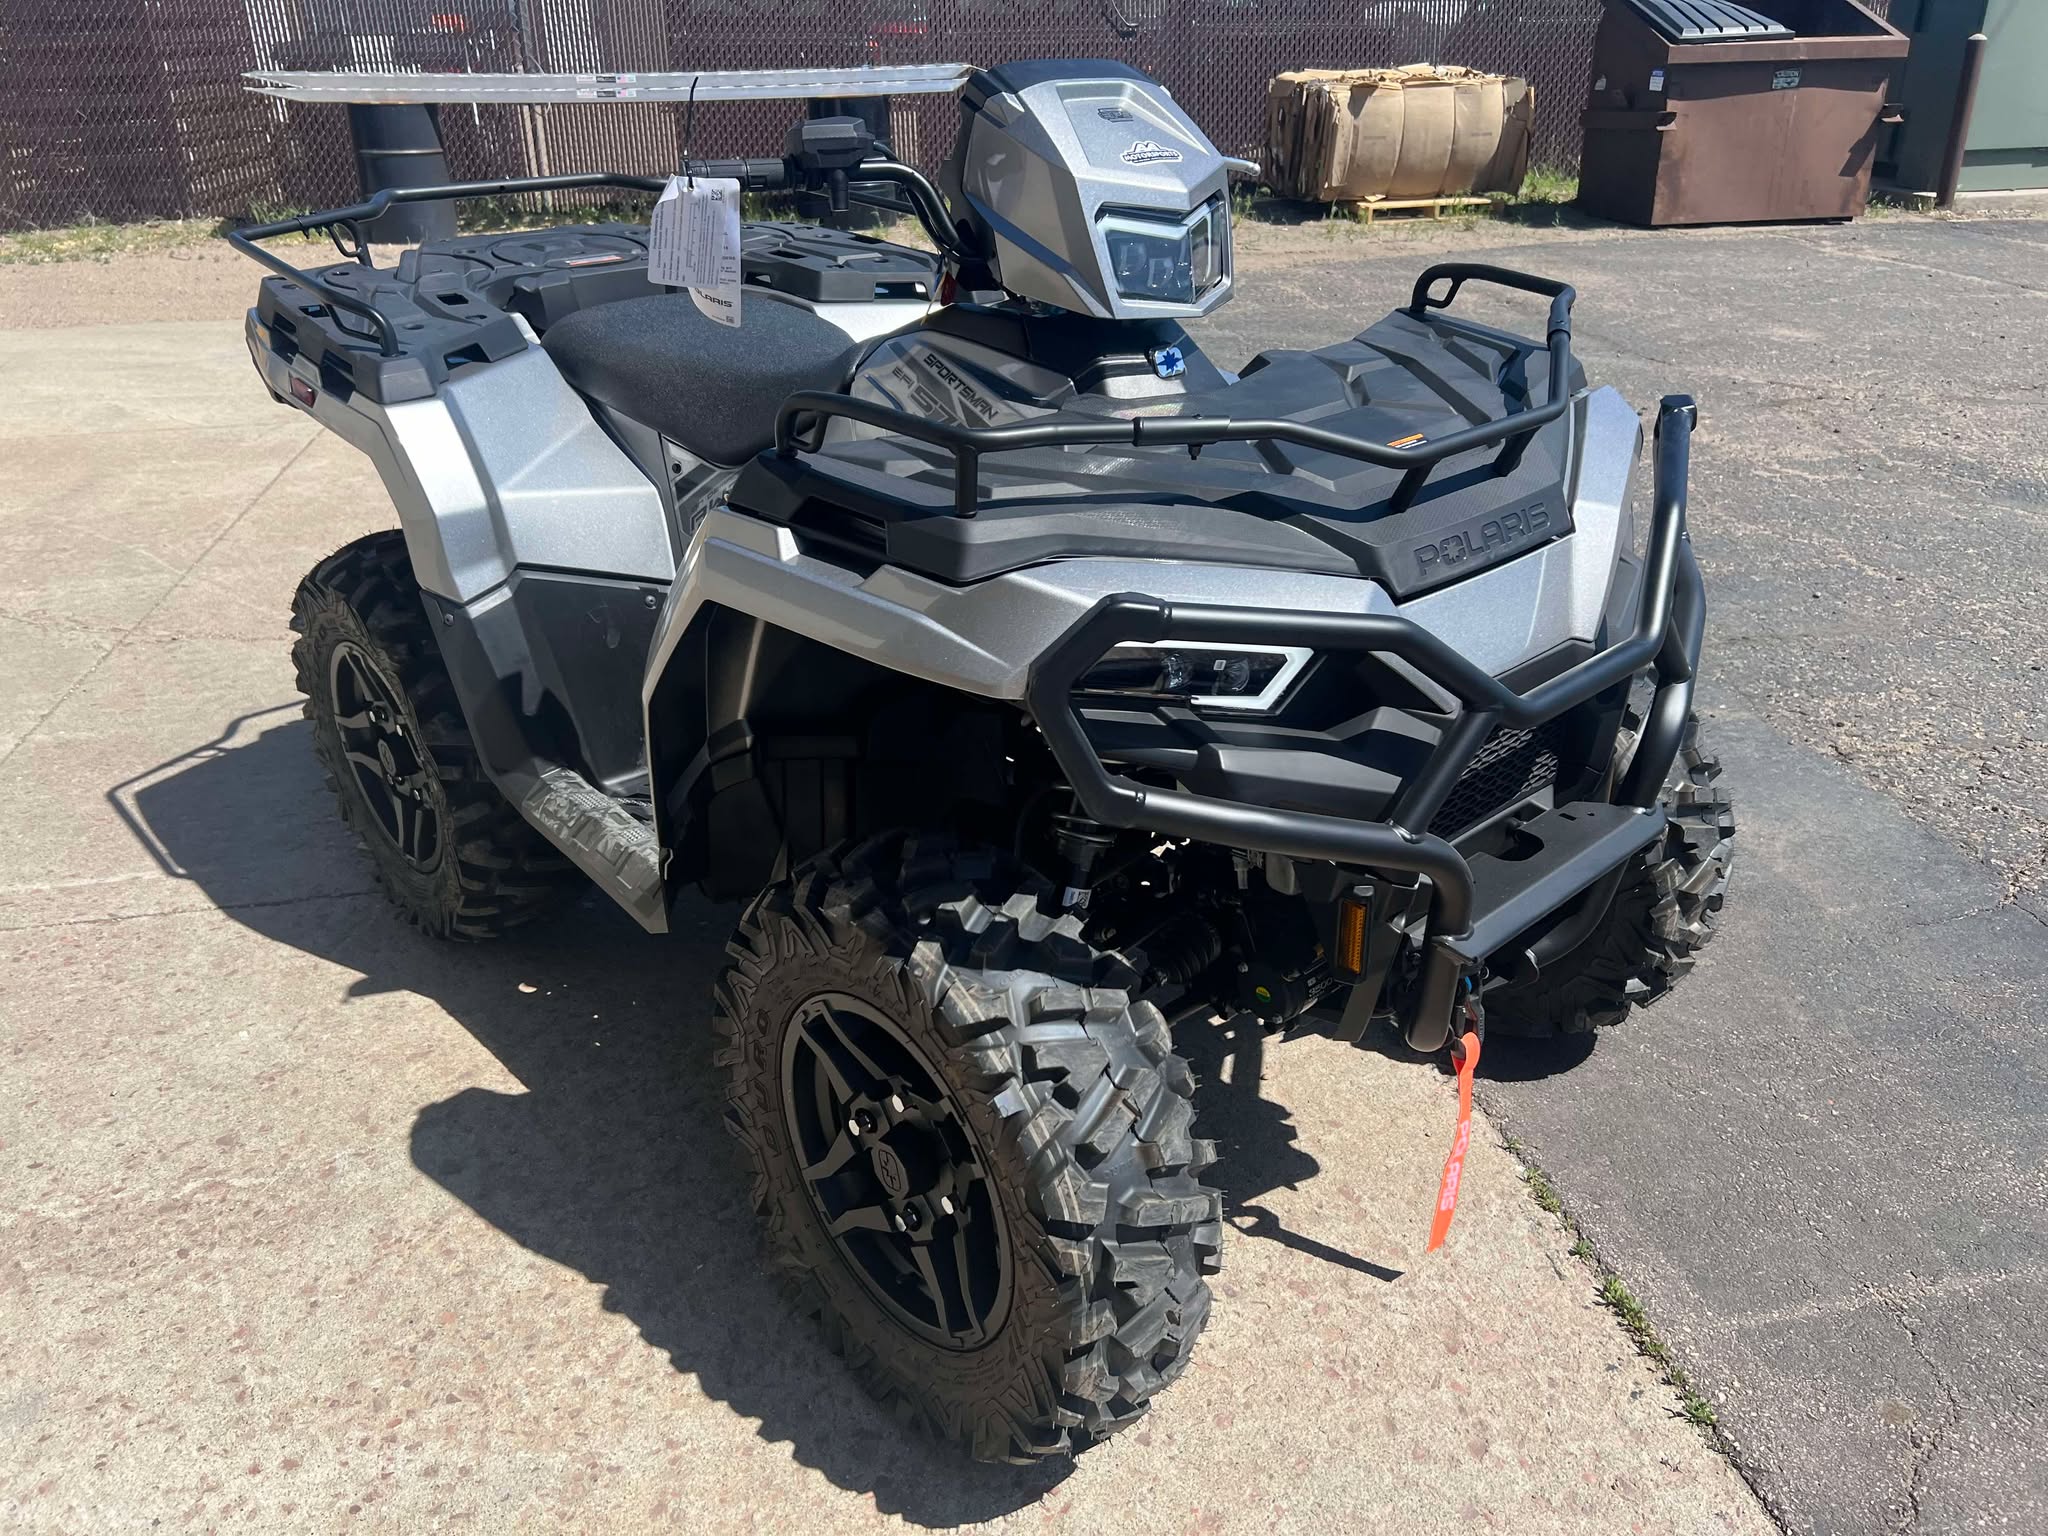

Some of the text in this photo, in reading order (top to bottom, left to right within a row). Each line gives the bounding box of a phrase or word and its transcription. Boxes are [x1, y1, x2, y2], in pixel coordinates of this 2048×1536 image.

[1123, 150, 1180, 161] MOTORSPORTS
[694, 287, 733, 308] OLARIS
[892, 366, 916, 389] EFI
[923, 353, 999, 421] SPORTSMAN
[1413, 502, 1551, 577] POLARIS
[753, 1008, 781, 1156] DURO
